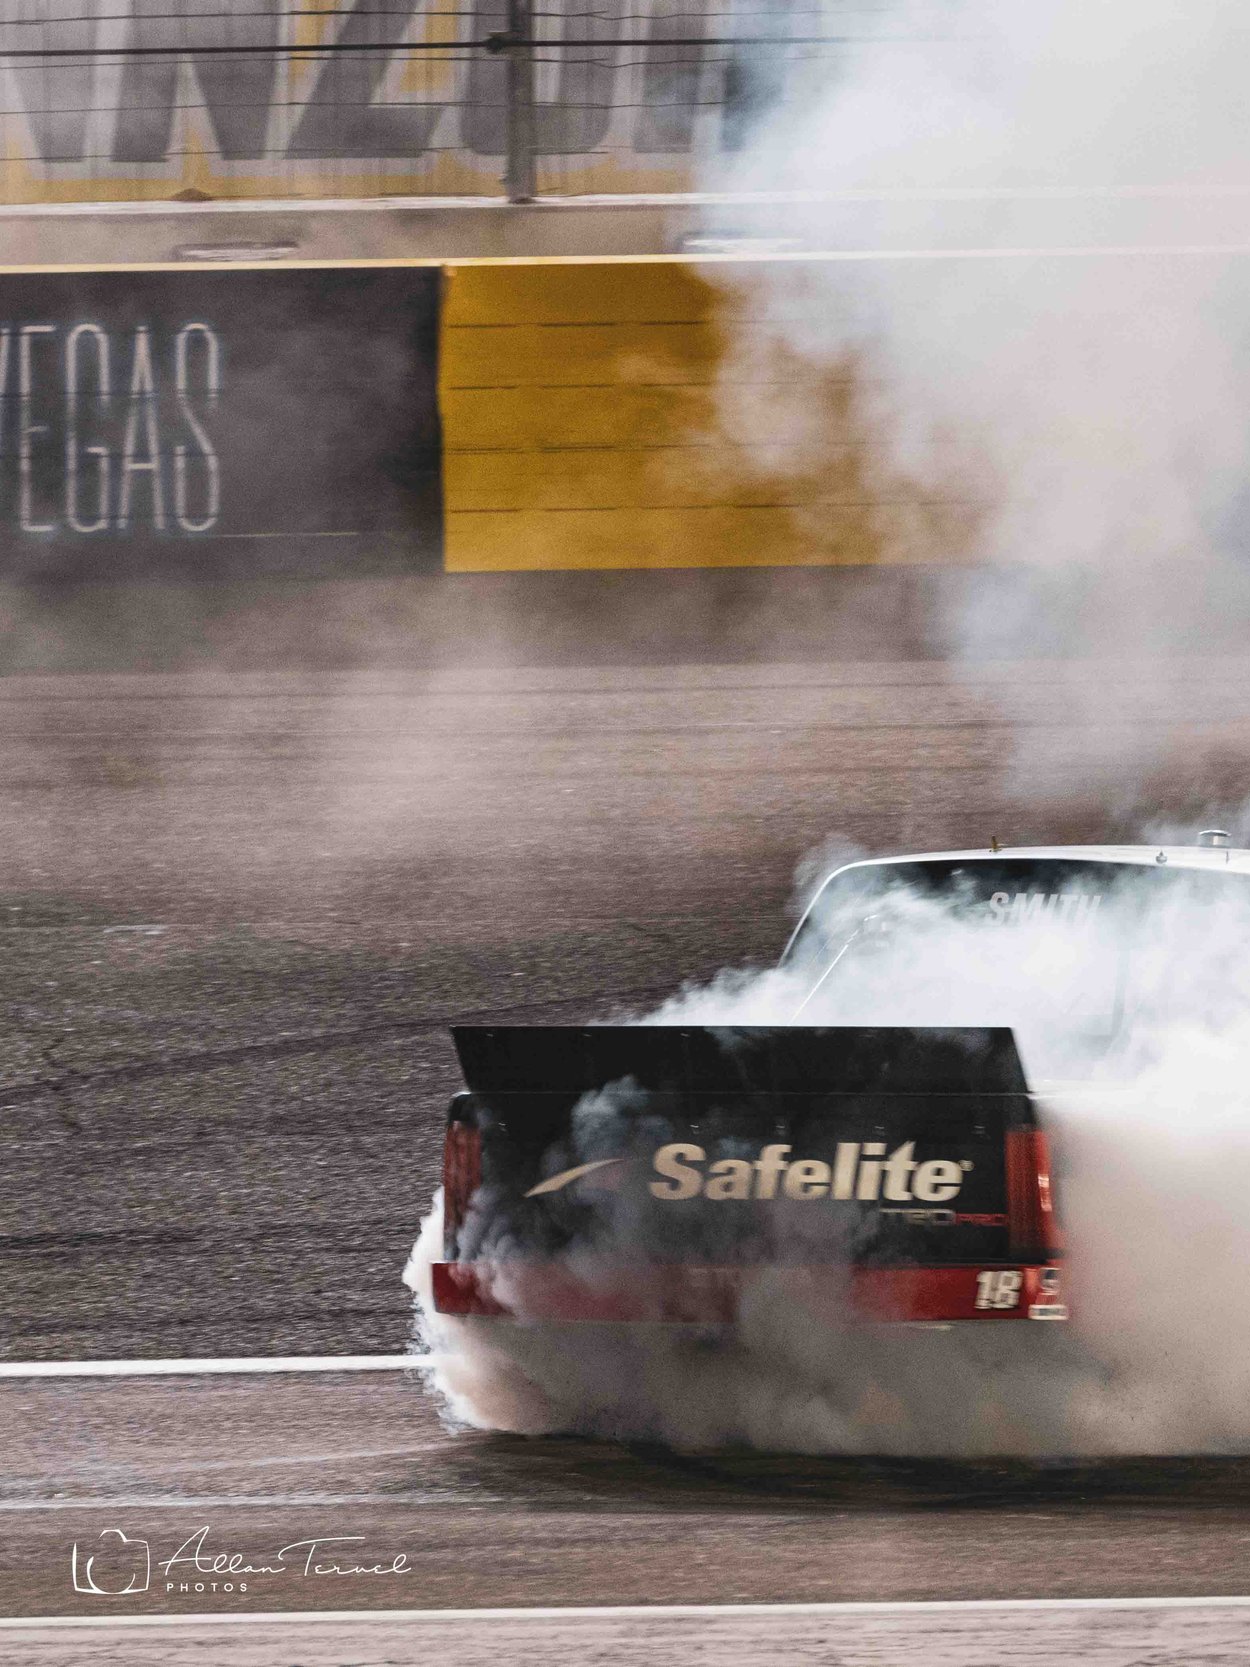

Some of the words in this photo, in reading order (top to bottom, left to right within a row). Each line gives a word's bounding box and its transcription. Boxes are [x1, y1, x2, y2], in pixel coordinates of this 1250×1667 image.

[985, 892, 1102, 924] SMITH
[649, 1141, 962, 1201] Safelite
[974, 1271, 1023, 1309] 18
